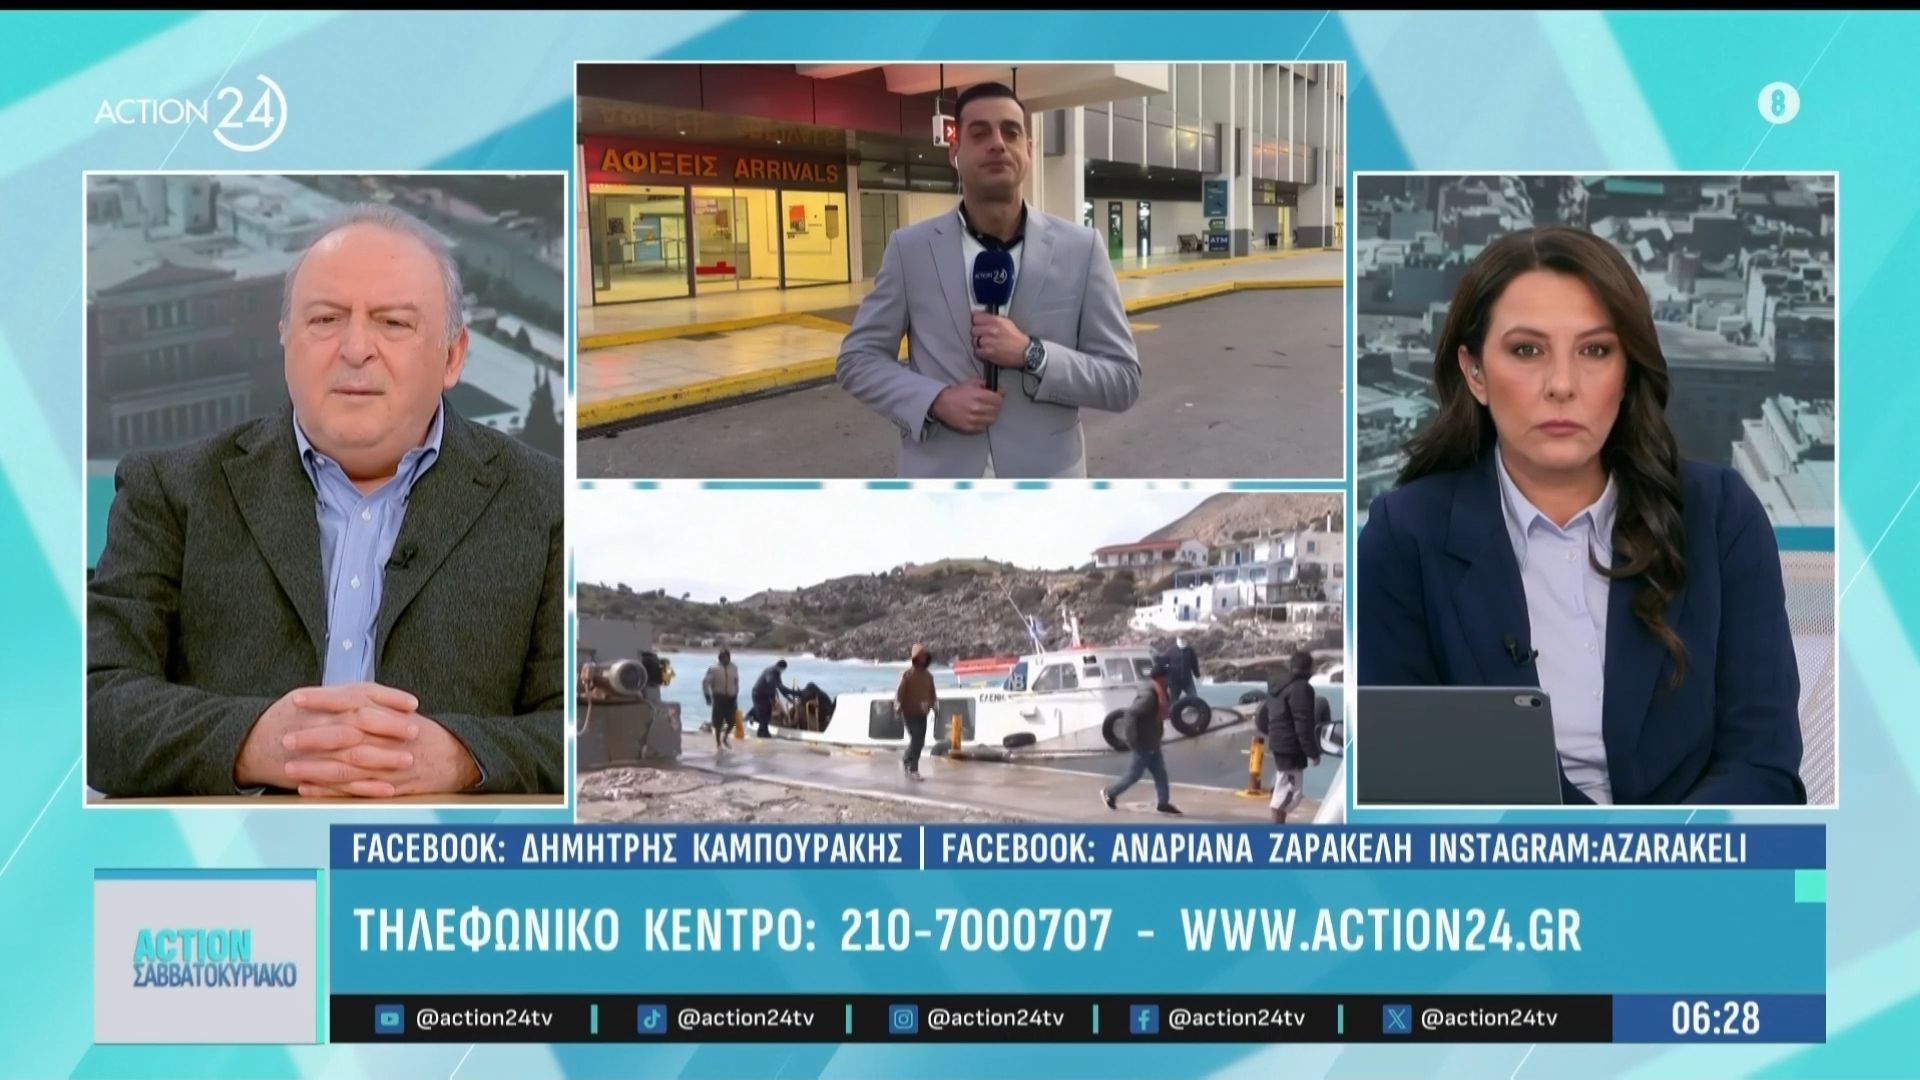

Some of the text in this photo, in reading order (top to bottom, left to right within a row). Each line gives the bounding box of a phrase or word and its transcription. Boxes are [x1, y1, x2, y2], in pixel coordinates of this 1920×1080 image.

[601, 148, 718, 177] ΑΦΙΞΕΙΣ
[734, 158, 839, 183] ARRIVALS
[1210, 236, 1228, 244] ATM
